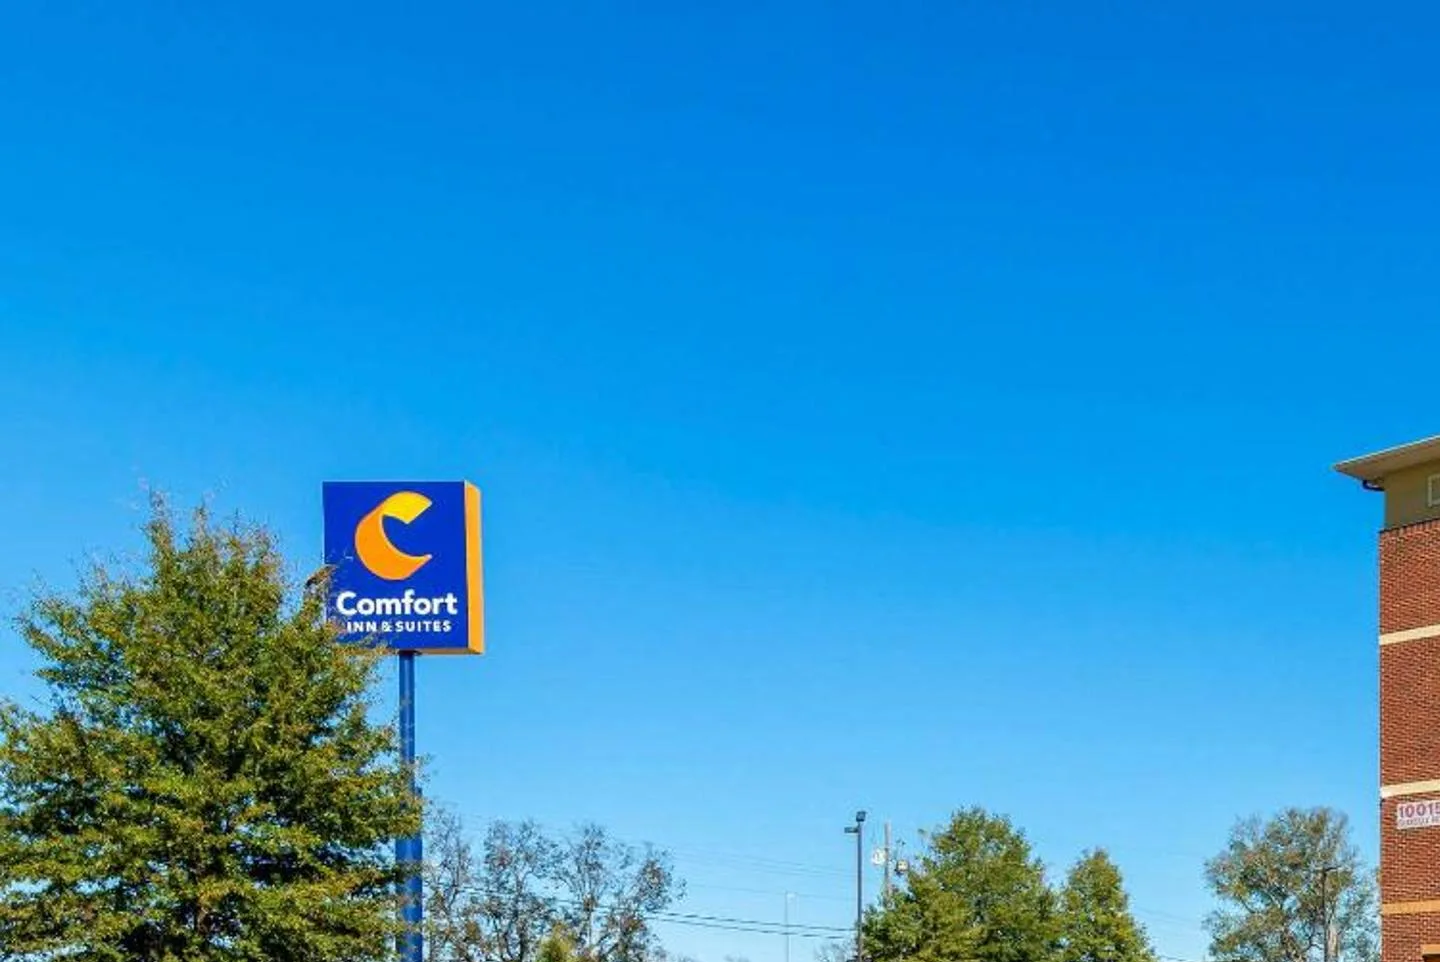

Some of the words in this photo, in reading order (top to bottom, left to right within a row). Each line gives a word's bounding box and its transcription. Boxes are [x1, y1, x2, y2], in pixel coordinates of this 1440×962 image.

[336, 588, 458, 616] Comfort
[346, 620, 377, 633] INN
[381, 621, 392, 632] &
[395, 620, 452, 632] SUITES
